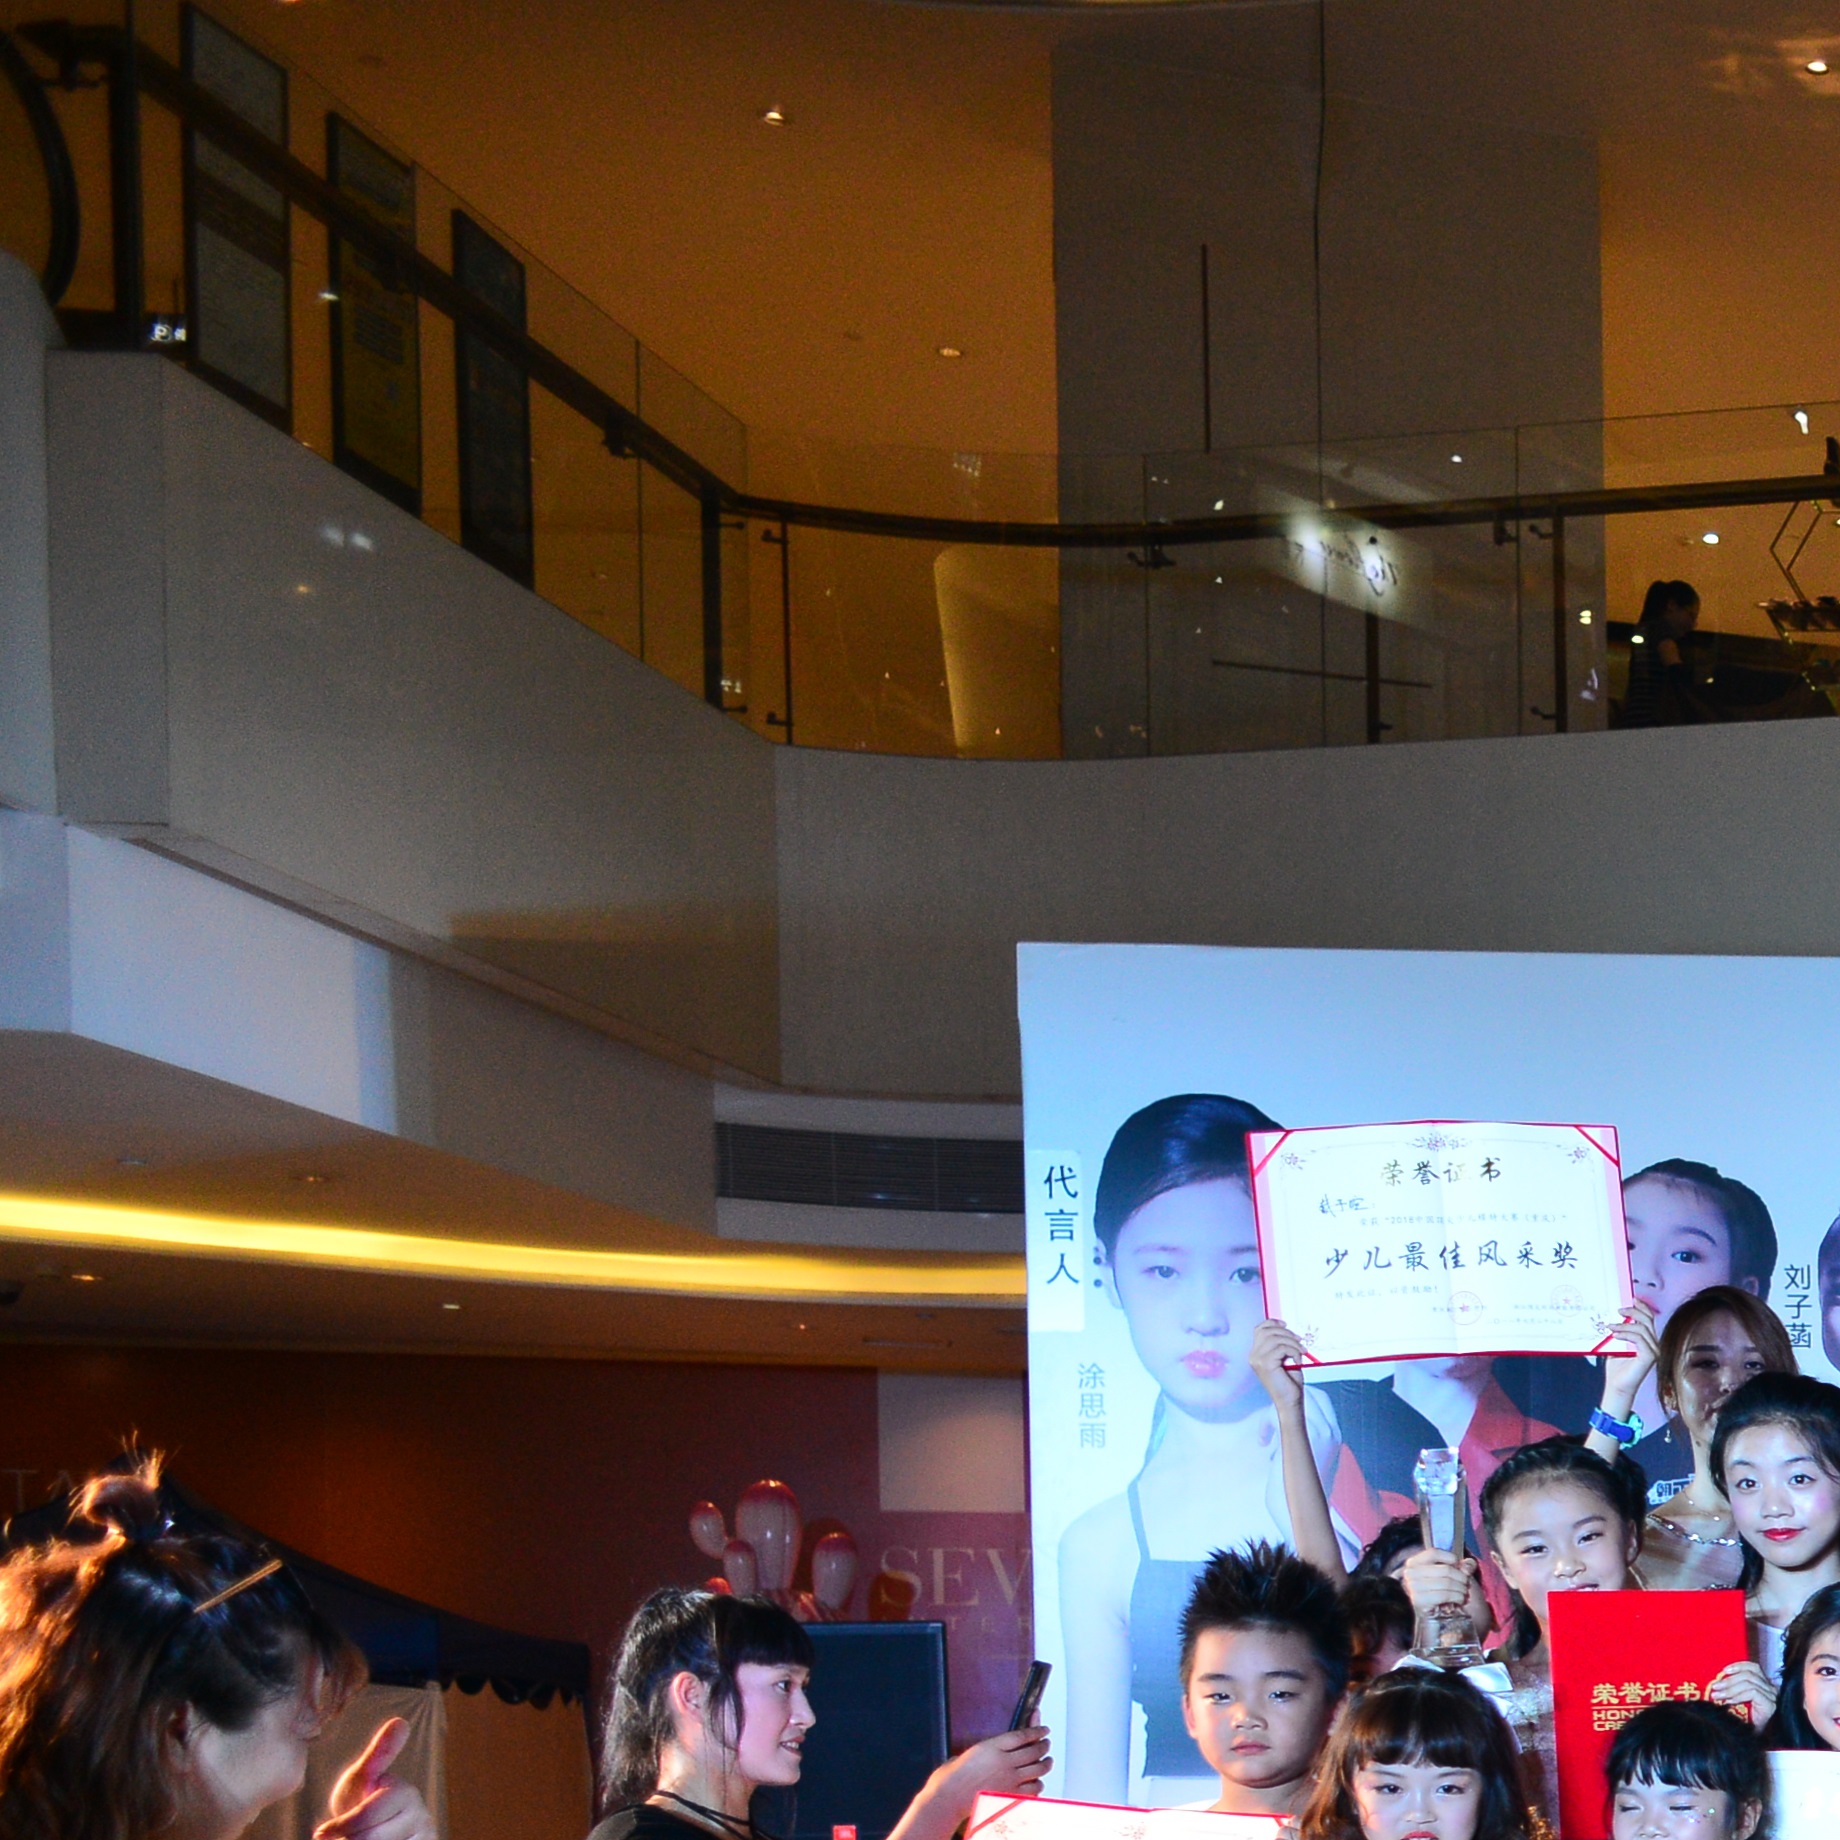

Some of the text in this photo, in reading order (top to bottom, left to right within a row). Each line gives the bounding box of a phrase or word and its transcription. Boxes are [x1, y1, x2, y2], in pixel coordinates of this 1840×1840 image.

[1381, 1157, 1502, 1186] 荣誉证书
[1044, 1165, 1079, 1285] 代言人
[1324, 1240, 1579, 1279] 少儿最佳风采奖
[1078, 1362, 1106, 1449] 涂思雨
[1591, 1682, 1700, 1704] 荣誉证书
